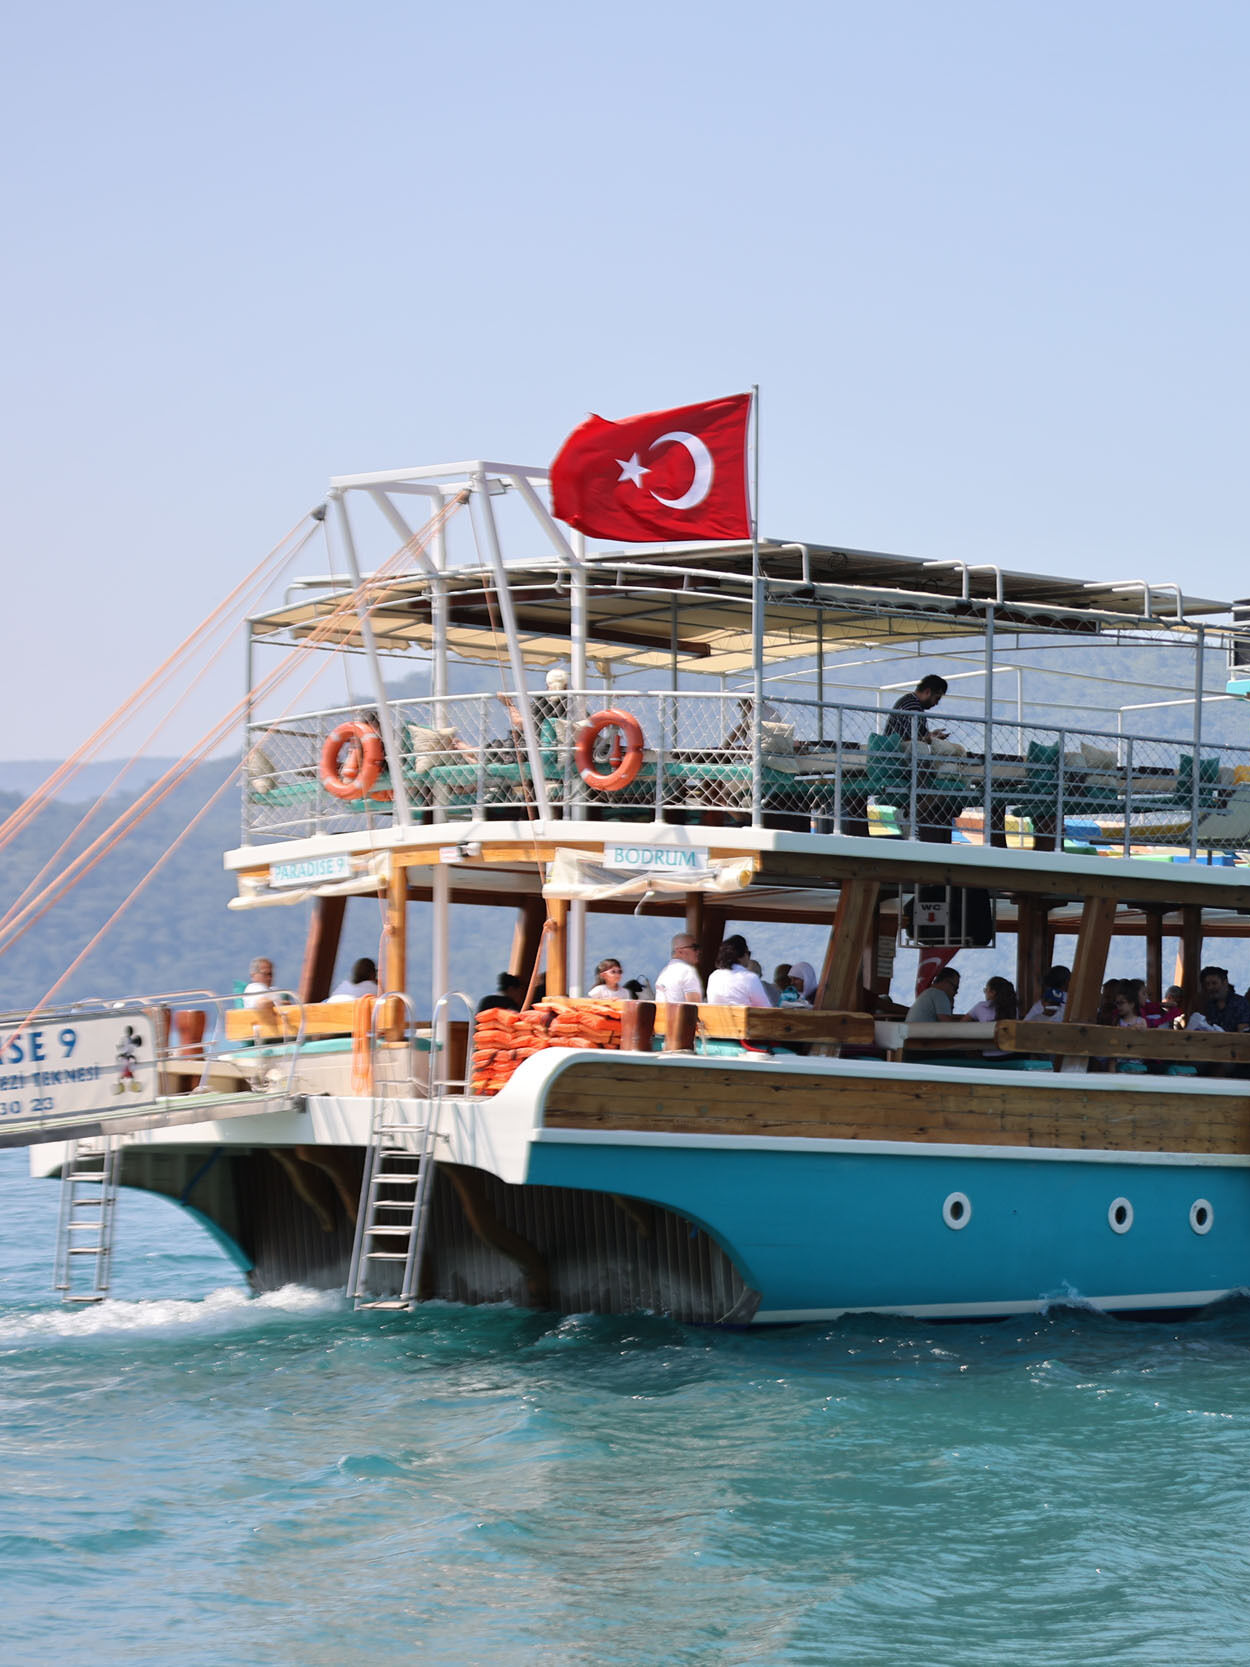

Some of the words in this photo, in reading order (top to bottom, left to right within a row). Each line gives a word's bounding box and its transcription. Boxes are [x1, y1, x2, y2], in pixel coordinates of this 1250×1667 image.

[614, 847, 696, 867] BODRUM
[274, 859, 333, 880] PARADISE
[336, 858, 345, 873] 9
[0, 1031, 46, 1065] SE
[58, 1028, 77, 1058] 9
[30, 1097, 54, 1112] 23
